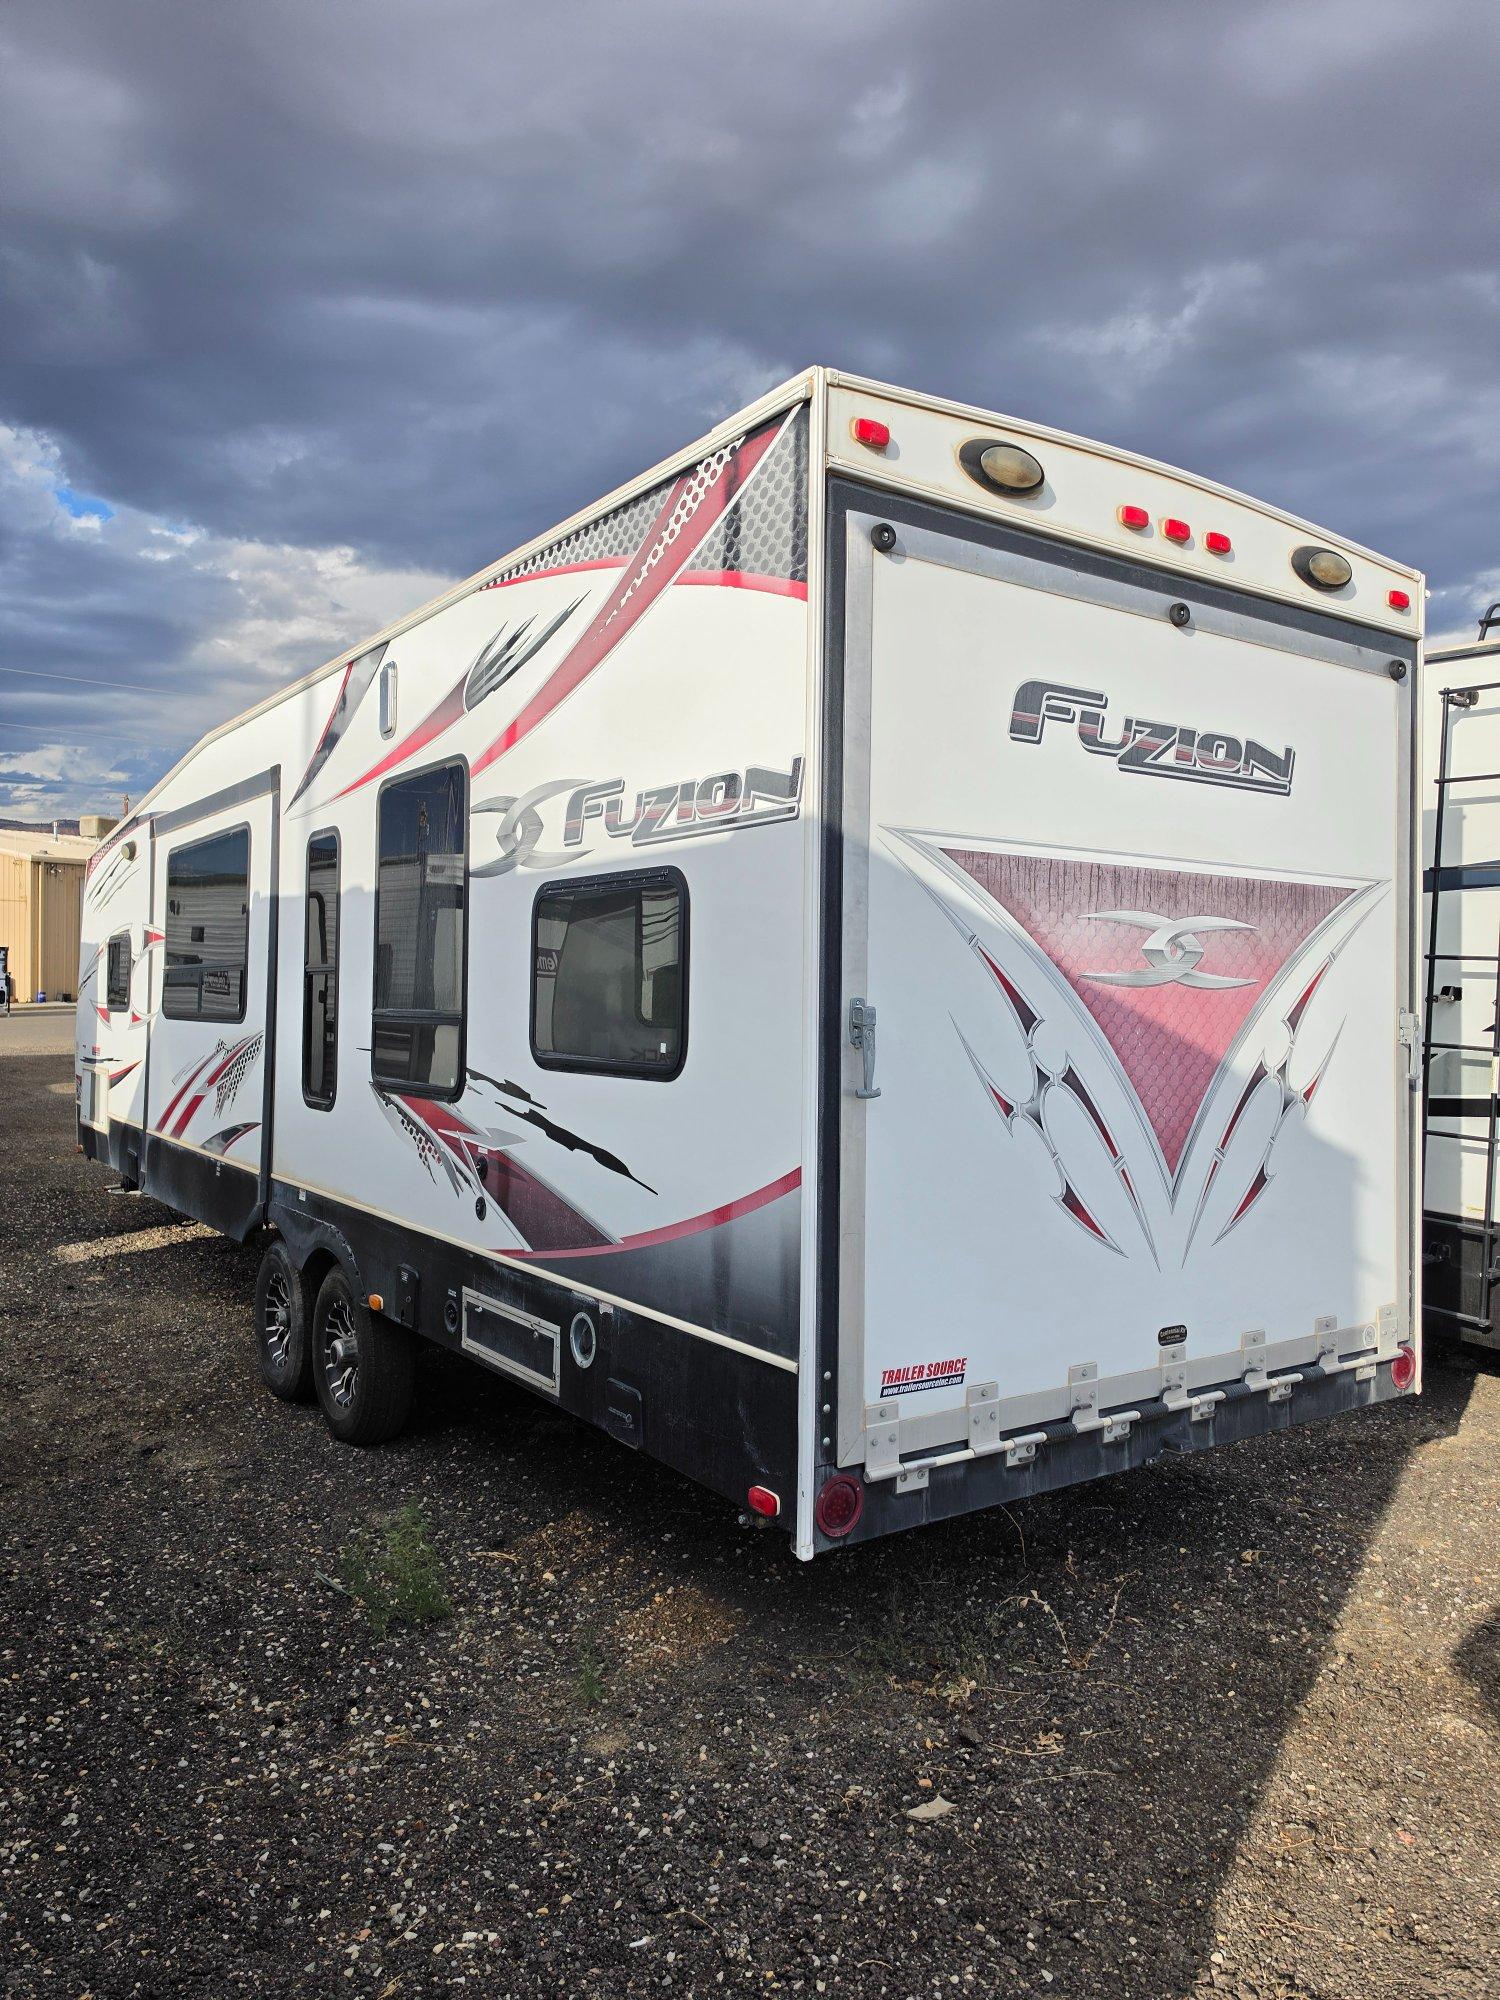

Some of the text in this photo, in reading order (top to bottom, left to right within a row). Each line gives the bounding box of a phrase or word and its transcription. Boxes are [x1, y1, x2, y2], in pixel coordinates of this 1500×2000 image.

[1008, 678, 1296, 797] FUZION
[563, 753, 805, 848] FUZION
[881, 1357, 968, 1385] TRAILER SOURCE
